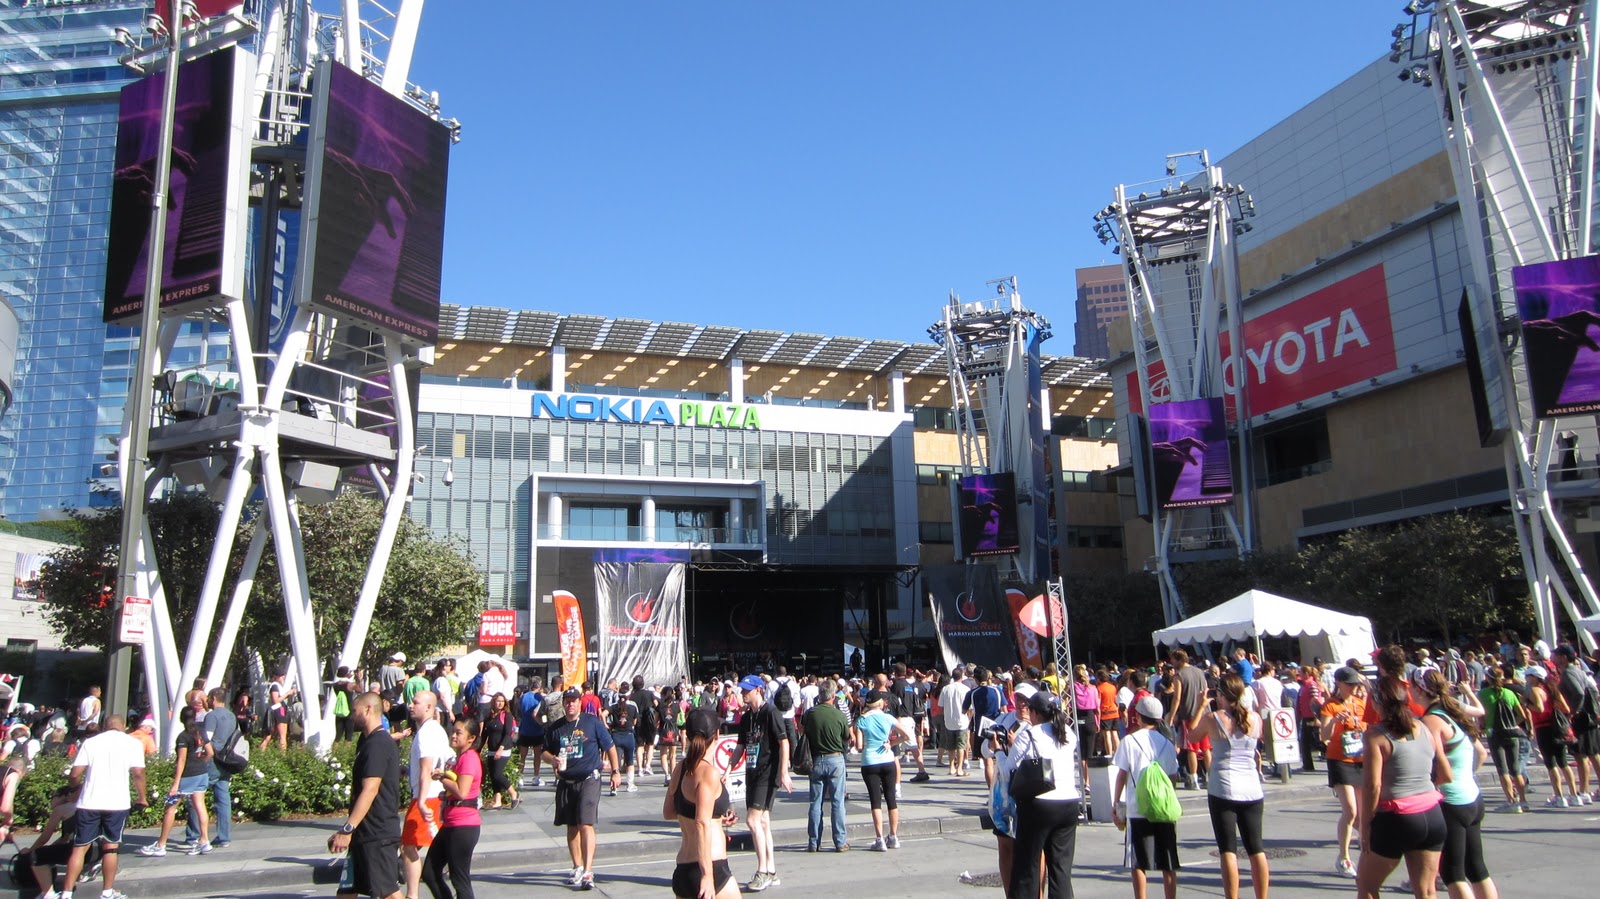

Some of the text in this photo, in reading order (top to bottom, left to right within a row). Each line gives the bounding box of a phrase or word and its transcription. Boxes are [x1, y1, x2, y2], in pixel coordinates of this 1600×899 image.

[165, 283, 211, 302] EXPRESS
[324, 293, 429, 337] AMERICAN EXPRESS
[531, 392, 761, 429] NOKIA PLAZA
[1546, 403, 1600, 415] AMERICAN
[570, 606, 582, 640] CAUSE
[1030, 601, 1048, 627] A
[482, 622, 513, 636] PUCK
